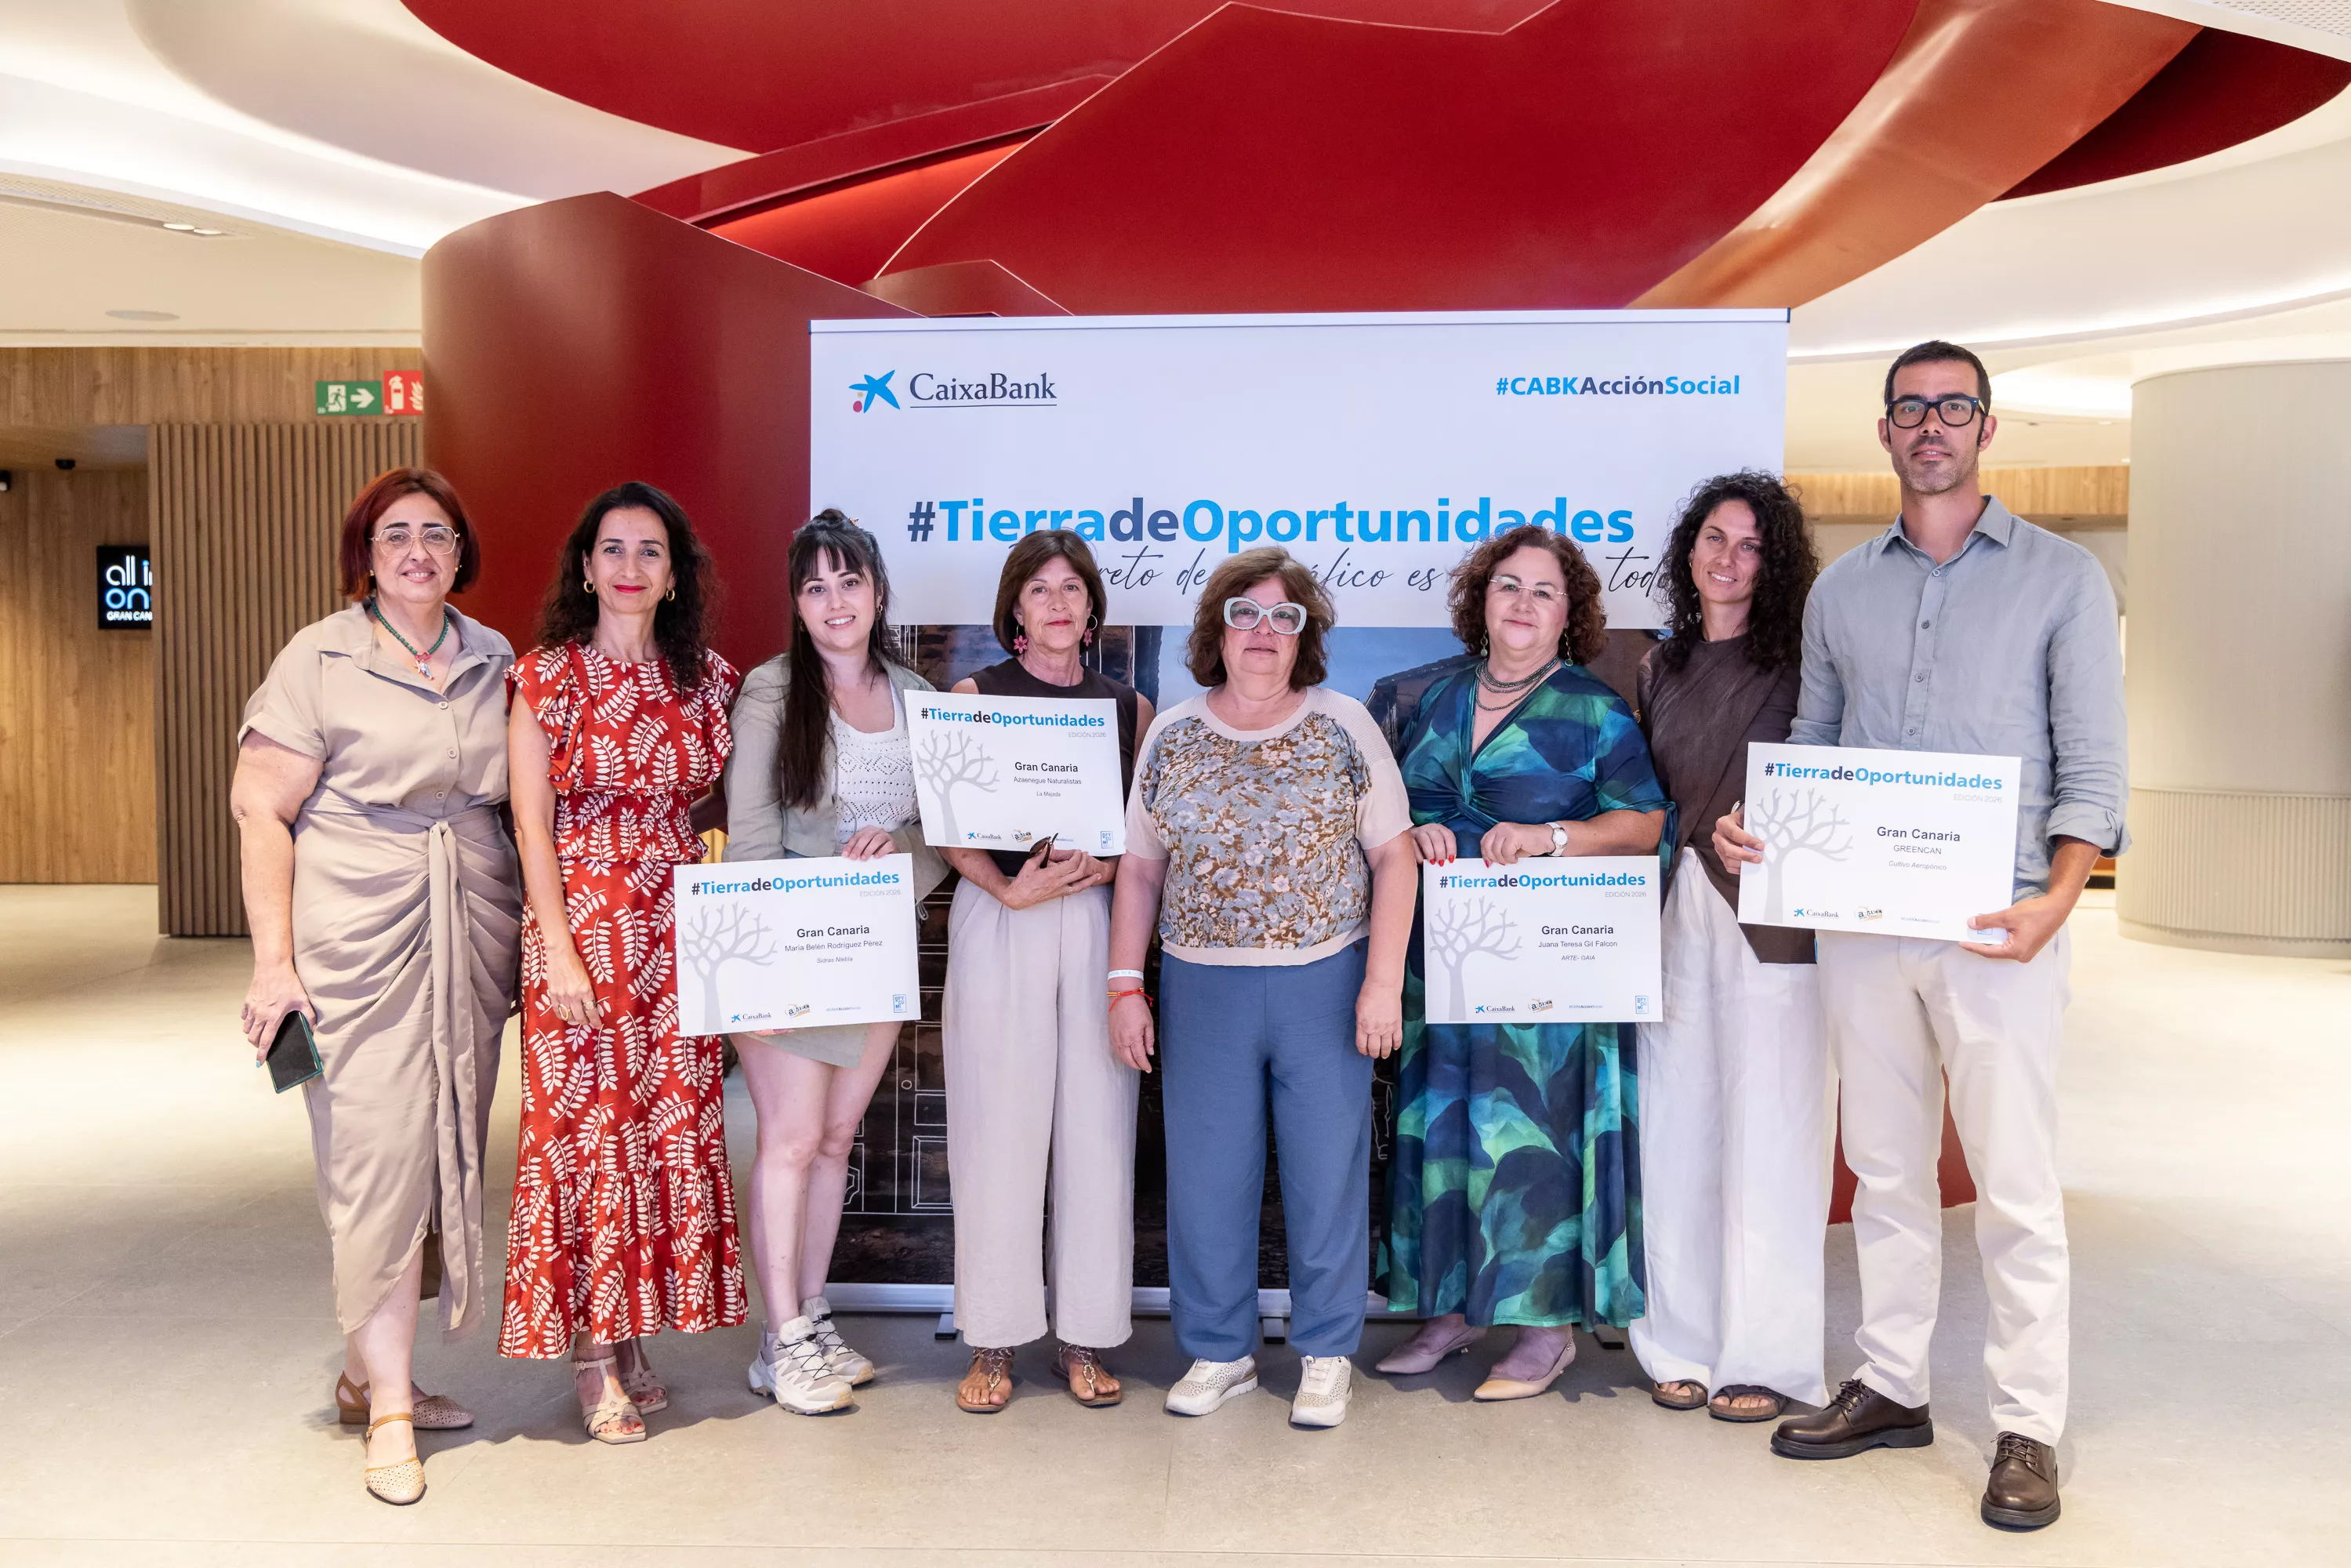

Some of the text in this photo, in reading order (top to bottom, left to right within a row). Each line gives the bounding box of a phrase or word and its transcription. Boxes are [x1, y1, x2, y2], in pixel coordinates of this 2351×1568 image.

[909, 372, 1057, 401] CaixaBank
[1496, 375, 1740, 395] #CABKAcciónSocial
[907, 497, 1634, 554] #TierradeOportunidades
[105, 554, 136, 586] all
[1407, 567, 1444, 591] es
[105, 587, 152, 609] on
[107, 611, 153, 621] GRAN CAN
[921, 707, 1105, 727] #TierradeOportunidades
[1014, 761, 1079, 772] Gran Canaria
[1014, 776, 1047, 785] Azaenegue
[1765, 762, 2003, 789] #TierradeOportunidades
[1954, 793, 1983, 802] EDICIÓN
[1877, 826, 1961, 842] Gran Canaria
[1893, 844, 1942, 855] GREENCAN
[691, 871, 900, 895] #TierradeOportunidades
[1439, 873, 1645, 890] #TierradeOportunidades
[859, 888, 885, 897] EDICIÓN
[1806, 909, 1839, 918] CaixaBank
[796, 925, 870, 938] Gran Canaria
[1541, 925, 1614, 935] Gran Canaria
